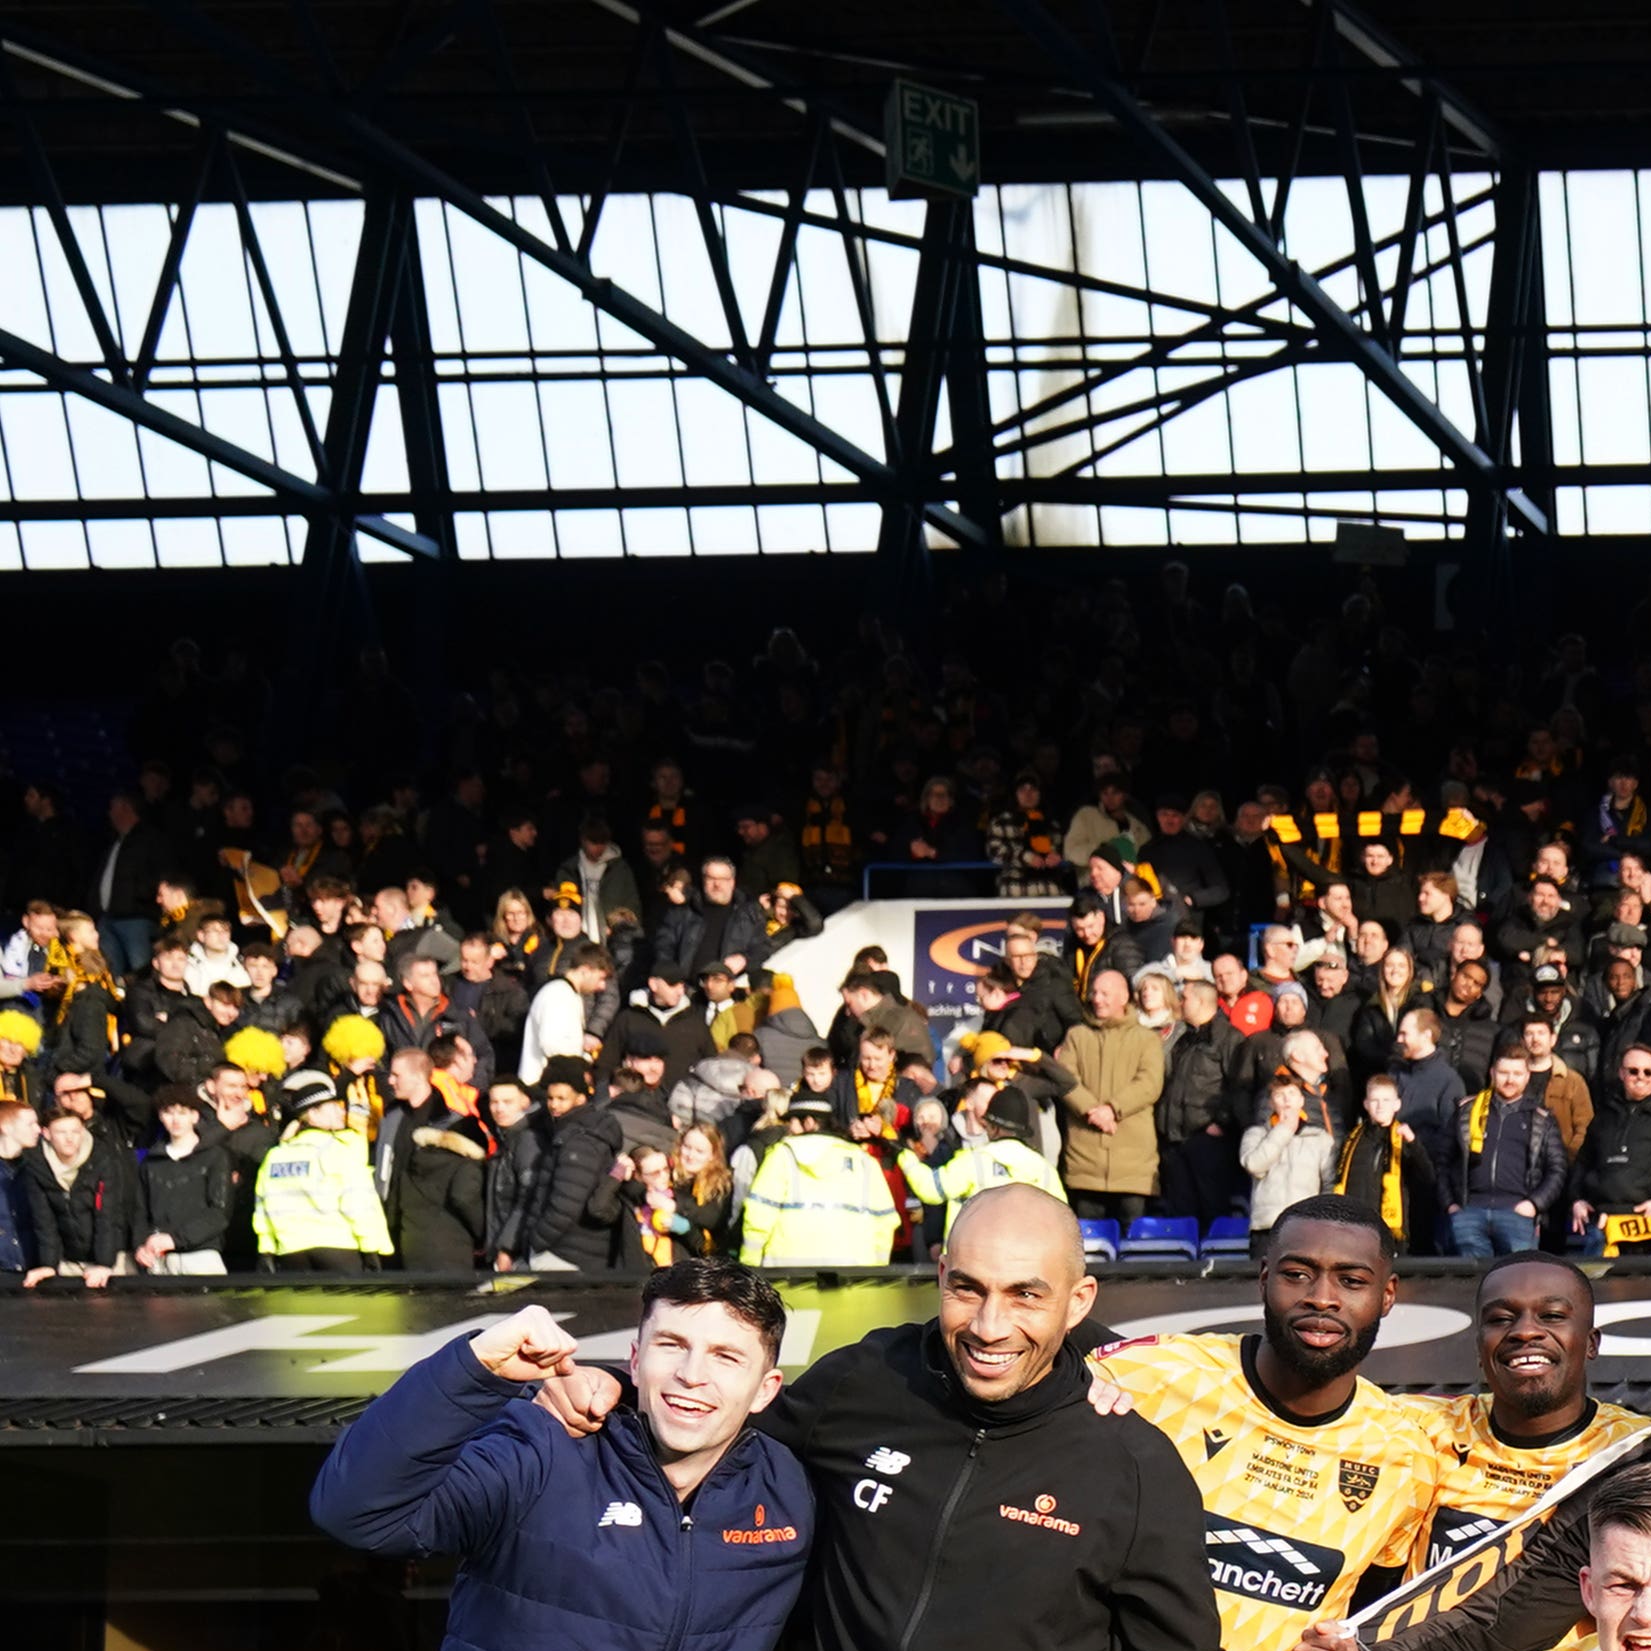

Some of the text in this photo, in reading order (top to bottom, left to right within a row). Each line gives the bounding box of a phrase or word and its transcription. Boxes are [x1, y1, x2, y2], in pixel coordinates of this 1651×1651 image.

[903, 88, 971, 135] EXIT
[1345, 1462, 1375, 1474] MUFC
[854, 1479, 894, 1513] CF
[723, 1526, 797, 1545] vanarama
[1000, 1504, 1081, 1537] vanarama
[1208, 1557, 1325, 1605] anchett
